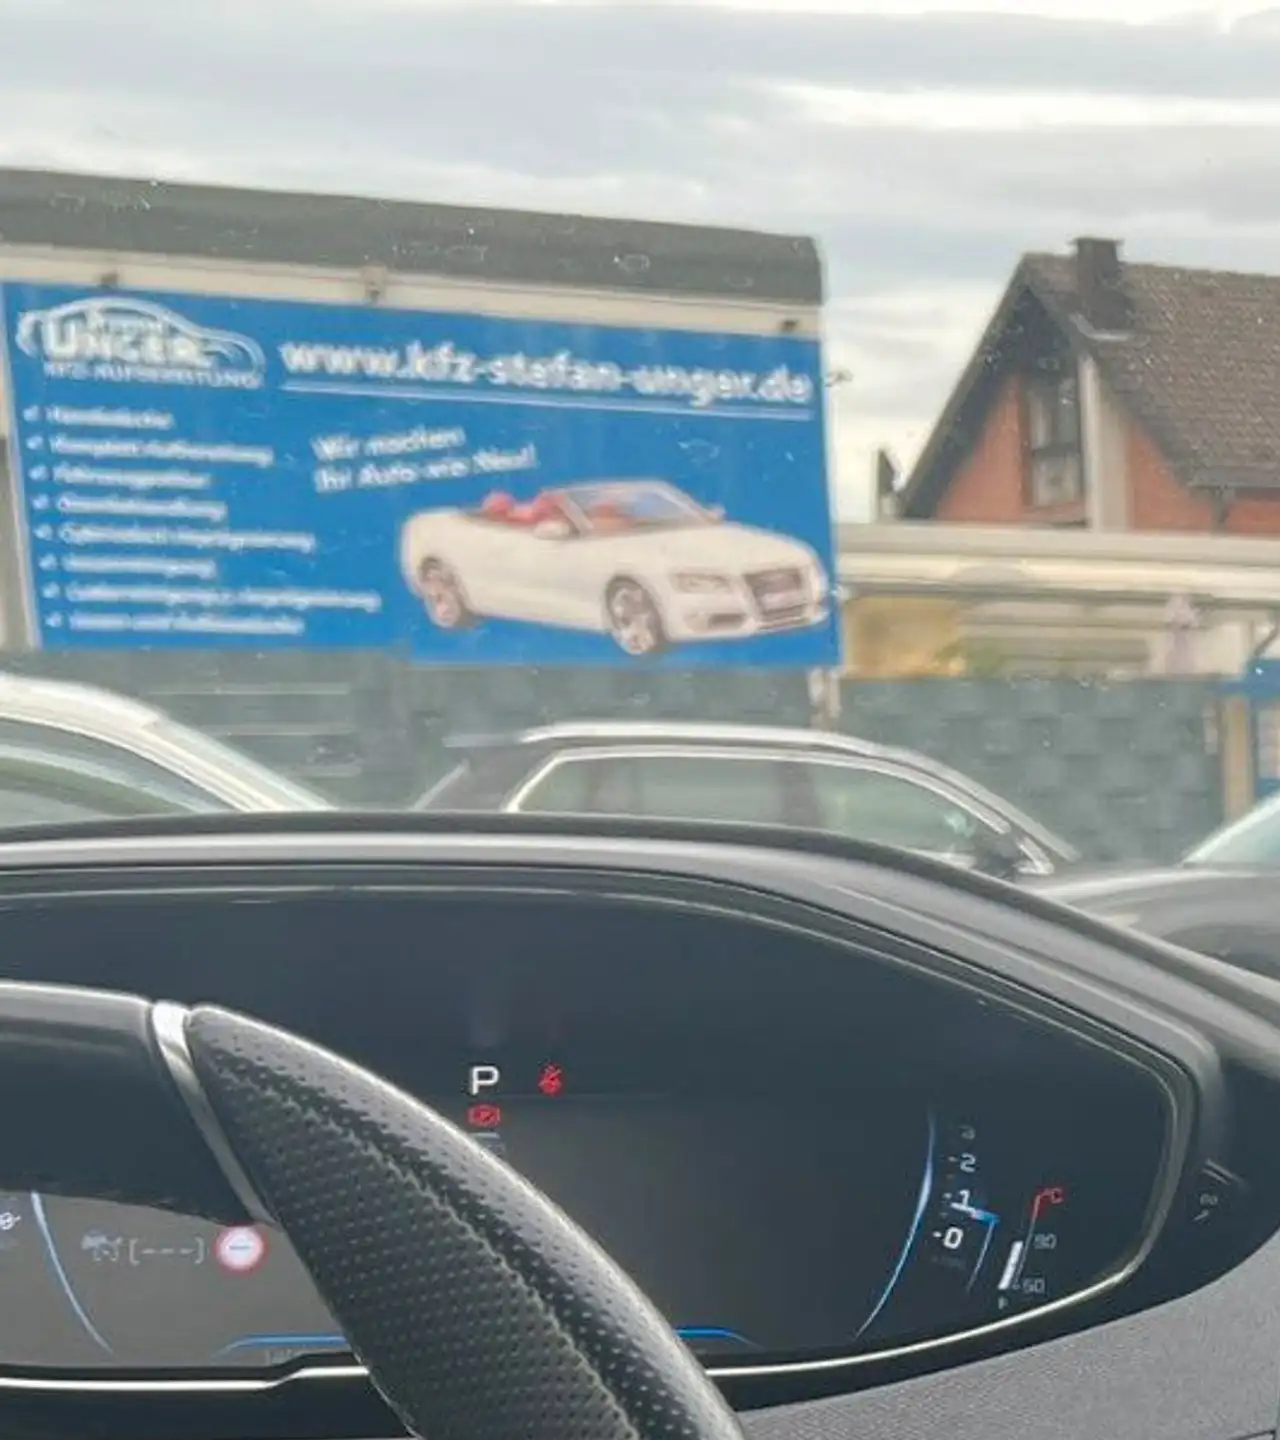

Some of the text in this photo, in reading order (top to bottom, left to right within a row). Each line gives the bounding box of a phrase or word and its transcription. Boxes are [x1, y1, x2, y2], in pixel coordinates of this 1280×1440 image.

[279, 340, 814, 407] www.kfz-stefan-unger.de
[357, 463, 419, 488] Auto
[472, 1065, 500, 1096] P
